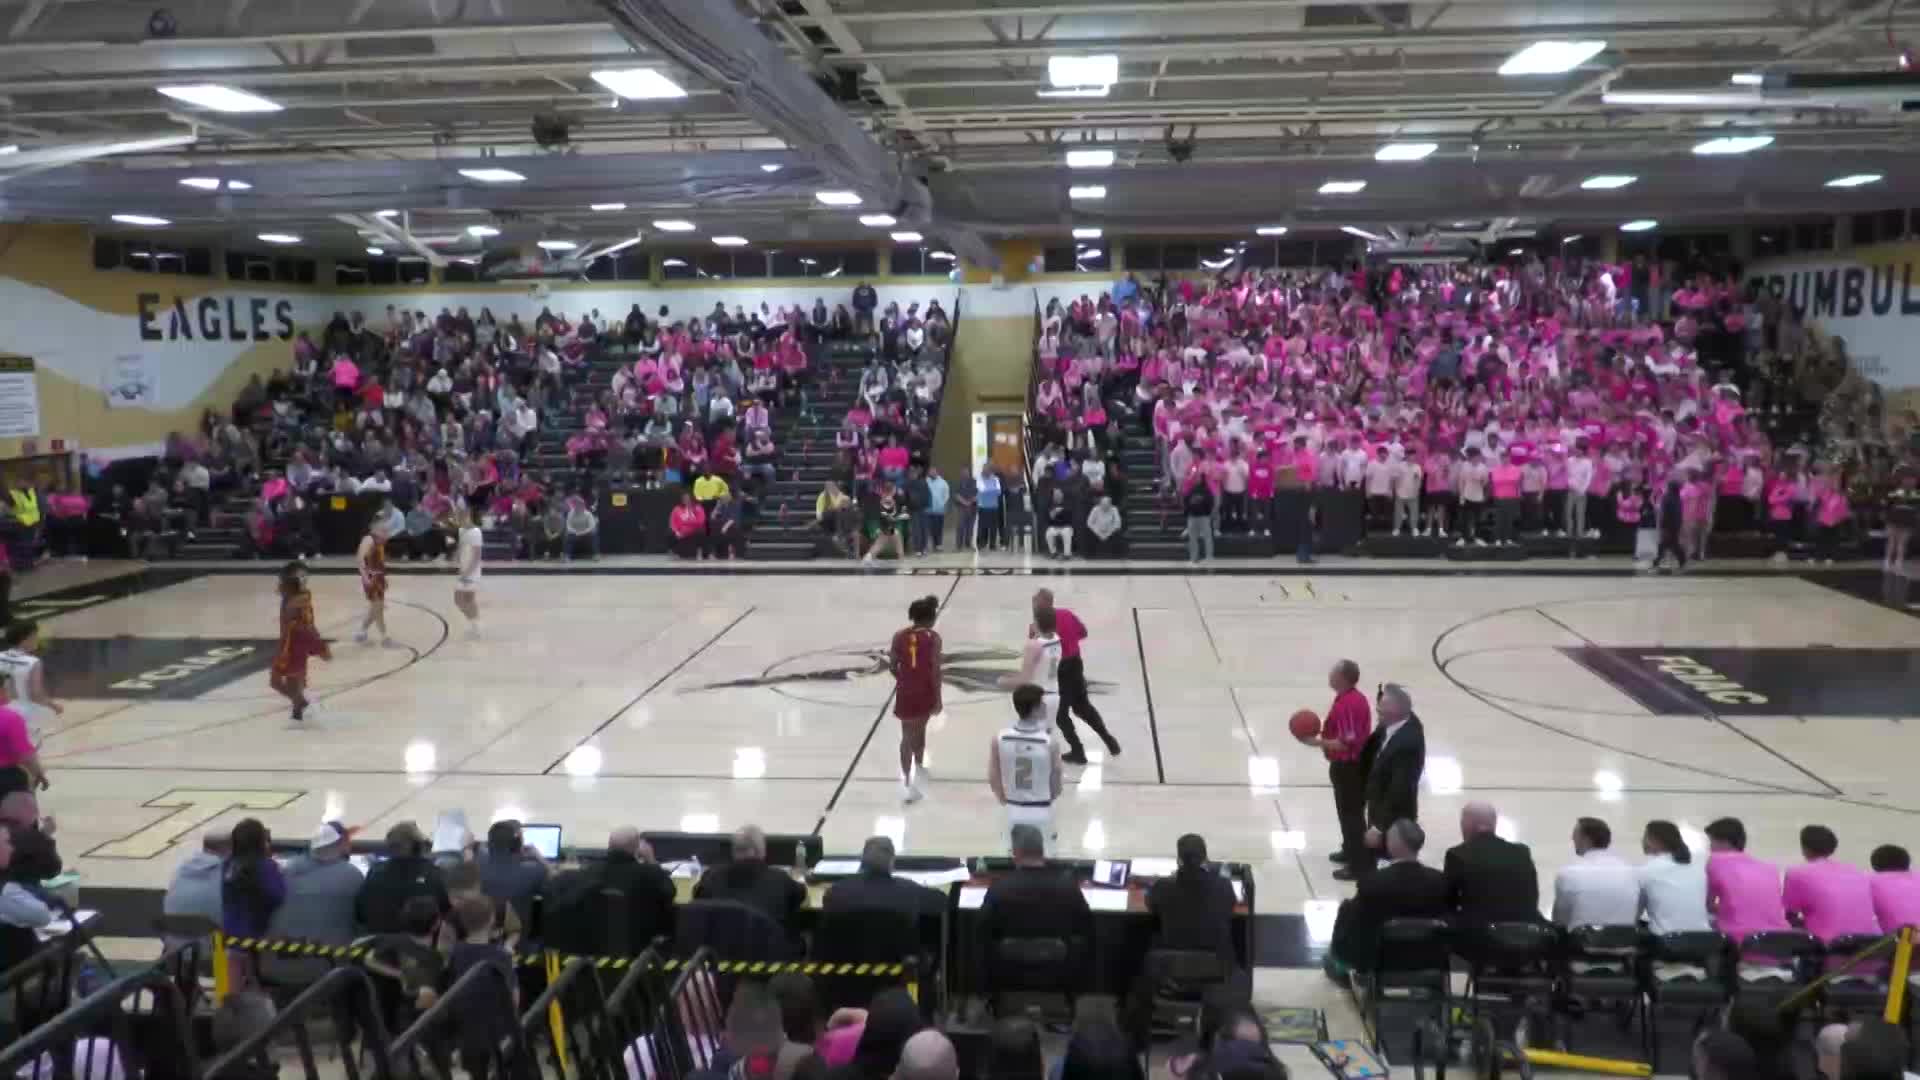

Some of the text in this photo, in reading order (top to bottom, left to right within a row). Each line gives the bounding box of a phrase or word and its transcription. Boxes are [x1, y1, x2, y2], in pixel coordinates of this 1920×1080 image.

[138, 293, 294, 341] EAGLES
[907, 634, 919, 669] 1
[1014, 757, 1034, 790] 2
[80, 787, 307, 860] T
